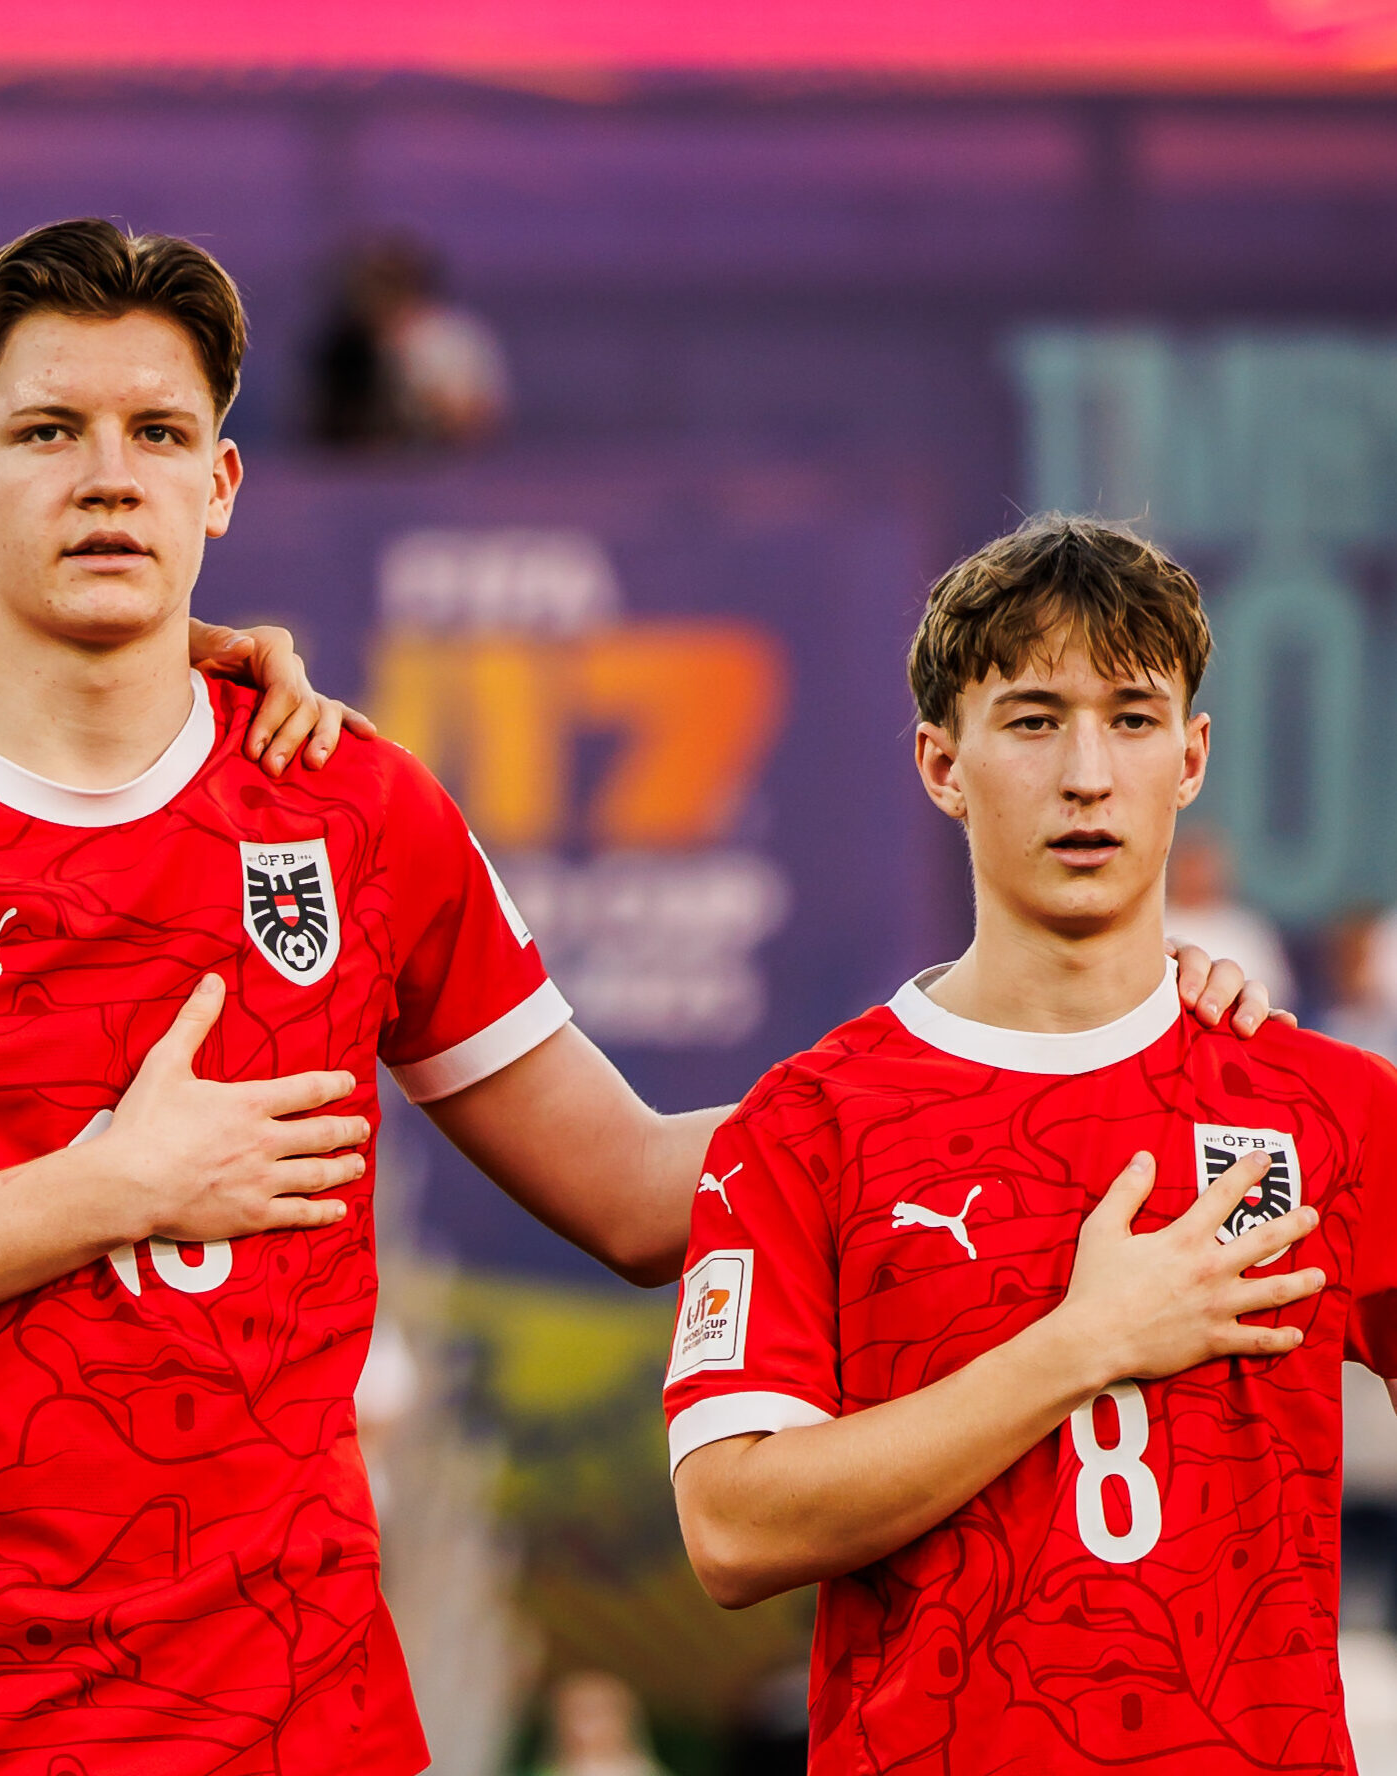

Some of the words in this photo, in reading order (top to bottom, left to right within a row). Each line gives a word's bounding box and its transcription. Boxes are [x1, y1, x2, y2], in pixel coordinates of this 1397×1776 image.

[258, 852, 295, 866] ÖFB
[1222, 1132, 1266, 1149] ÖFB
[704, 1319, 728, 1330] CUP
[1069, 1377, 1163, 1565] 8
